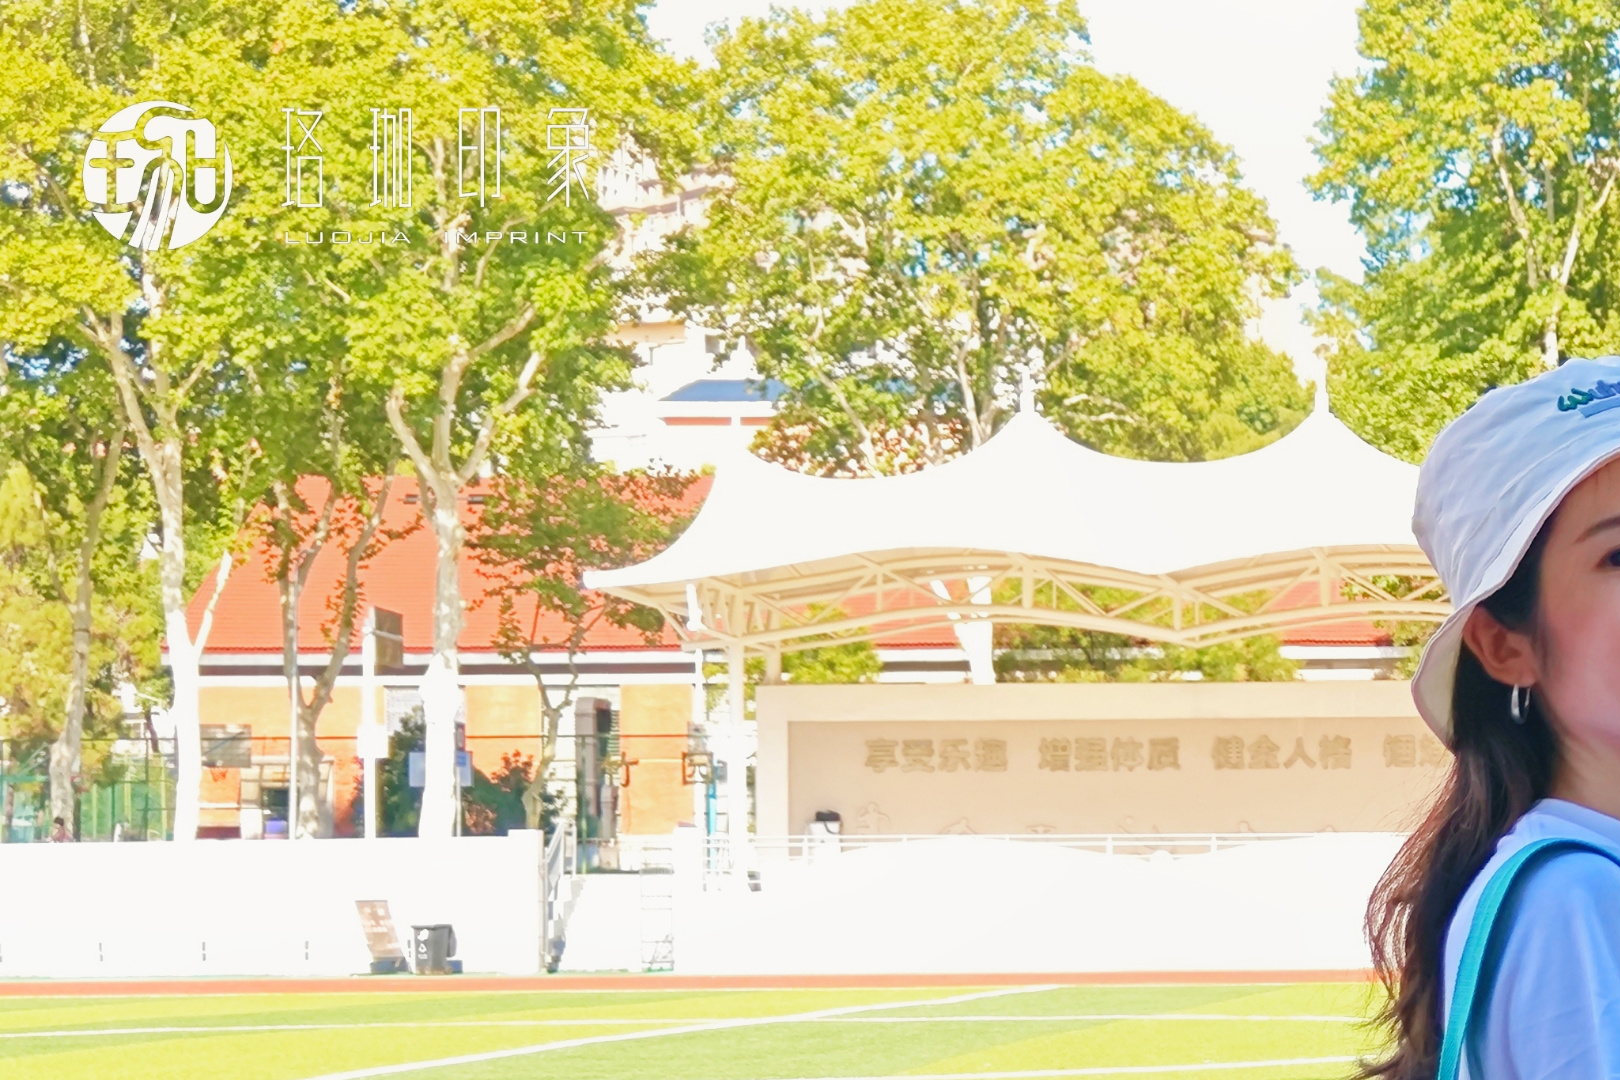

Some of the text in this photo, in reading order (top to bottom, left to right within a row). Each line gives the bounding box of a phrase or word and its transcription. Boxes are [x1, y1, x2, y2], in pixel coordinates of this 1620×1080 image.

[864, 736, 1008, 774] 享受乐趣
[1038, 735, 1182, 773] 增强体质
[1211, 733, 1353, 770] 健全人格
